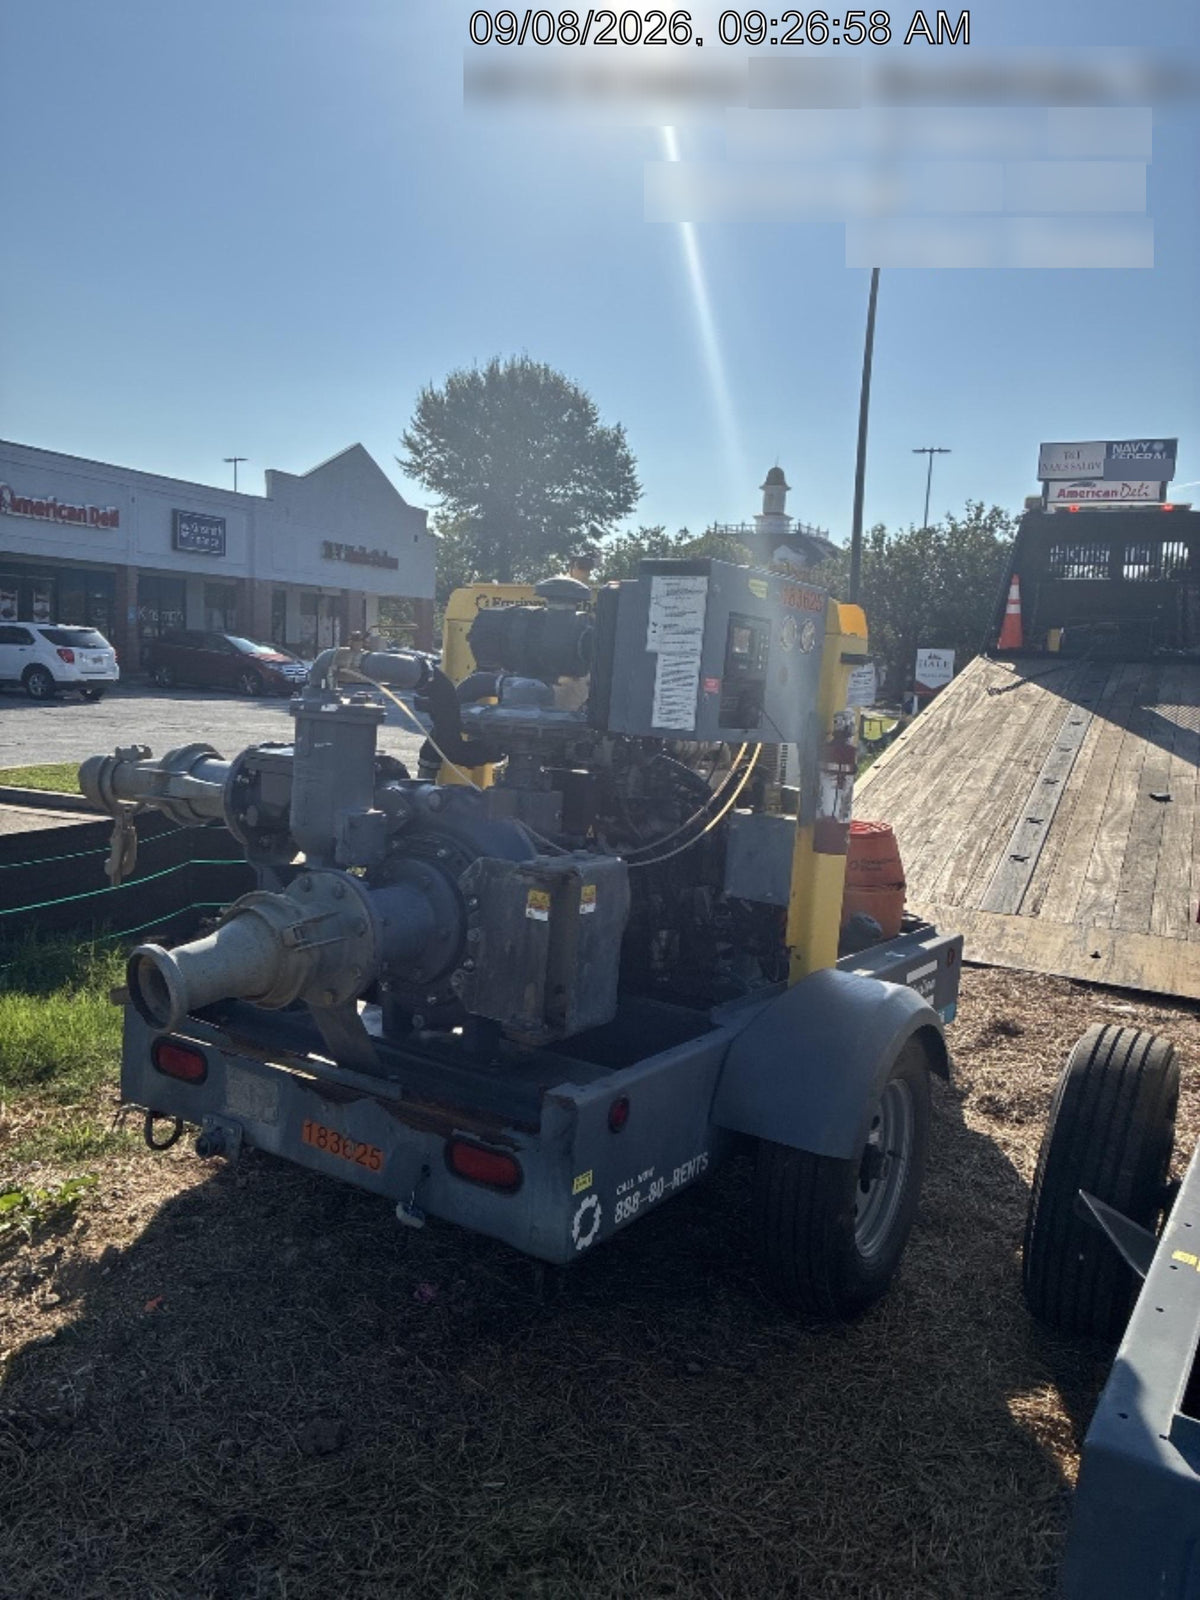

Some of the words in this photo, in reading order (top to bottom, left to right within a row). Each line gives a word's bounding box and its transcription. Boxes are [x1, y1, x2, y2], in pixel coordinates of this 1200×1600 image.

[1112, 442, 1150, 453] NAVY
[1057, 488, 1118, 499] American
[1119, 483, 1150, 498] Deli
[614, 1152, 708, 1224] 888-80-RENTS
